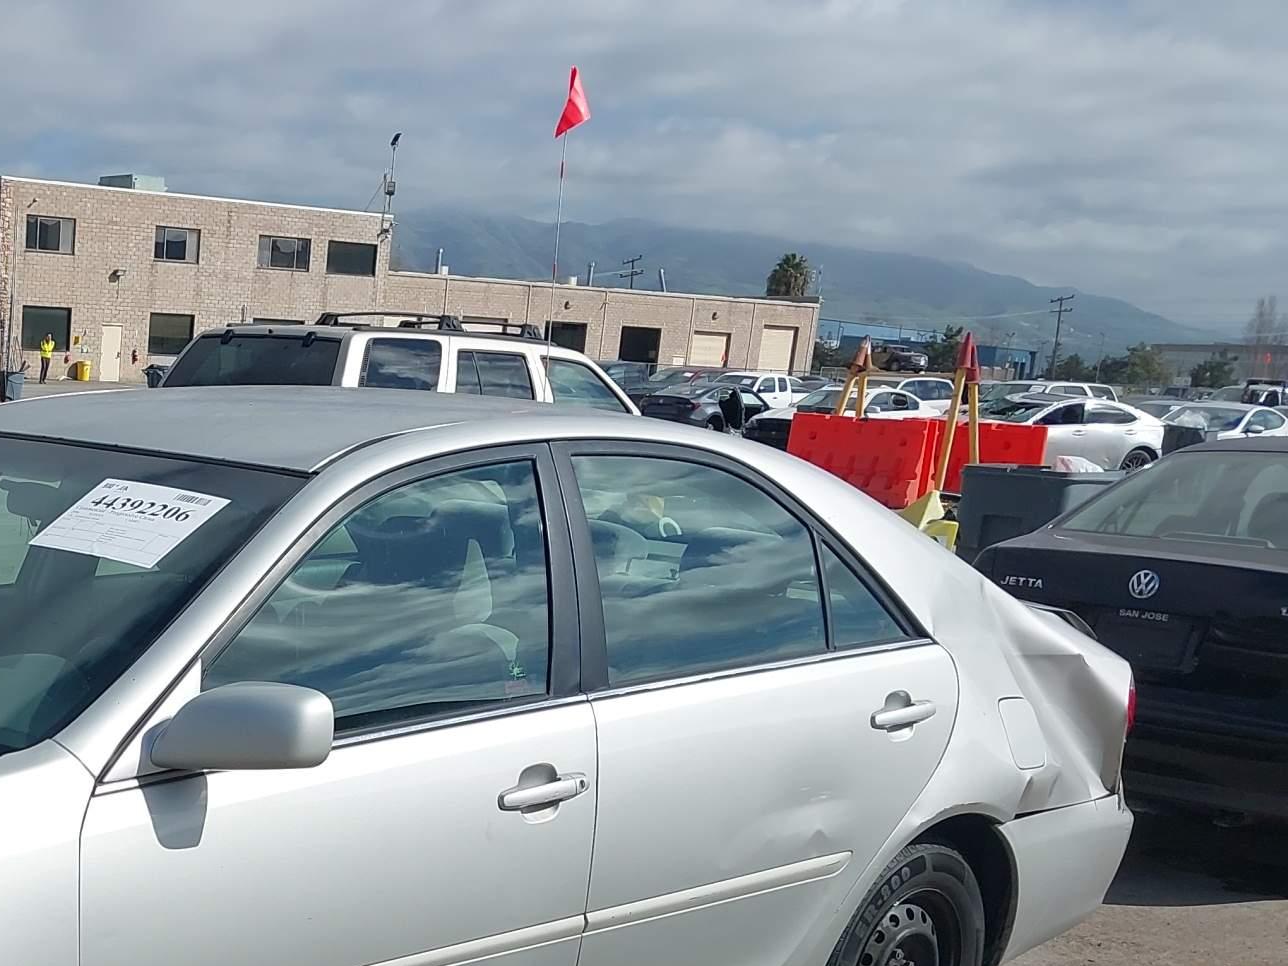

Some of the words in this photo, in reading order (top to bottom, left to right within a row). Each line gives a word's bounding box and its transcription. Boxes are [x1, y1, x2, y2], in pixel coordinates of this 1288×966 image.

[91, 494, 196, 523] 44392206
[1000, 575, 1044, 589] JETTA
[1119, 608, 1139, 618] SAN
[1140, 610, 1169, 622] JOSE
